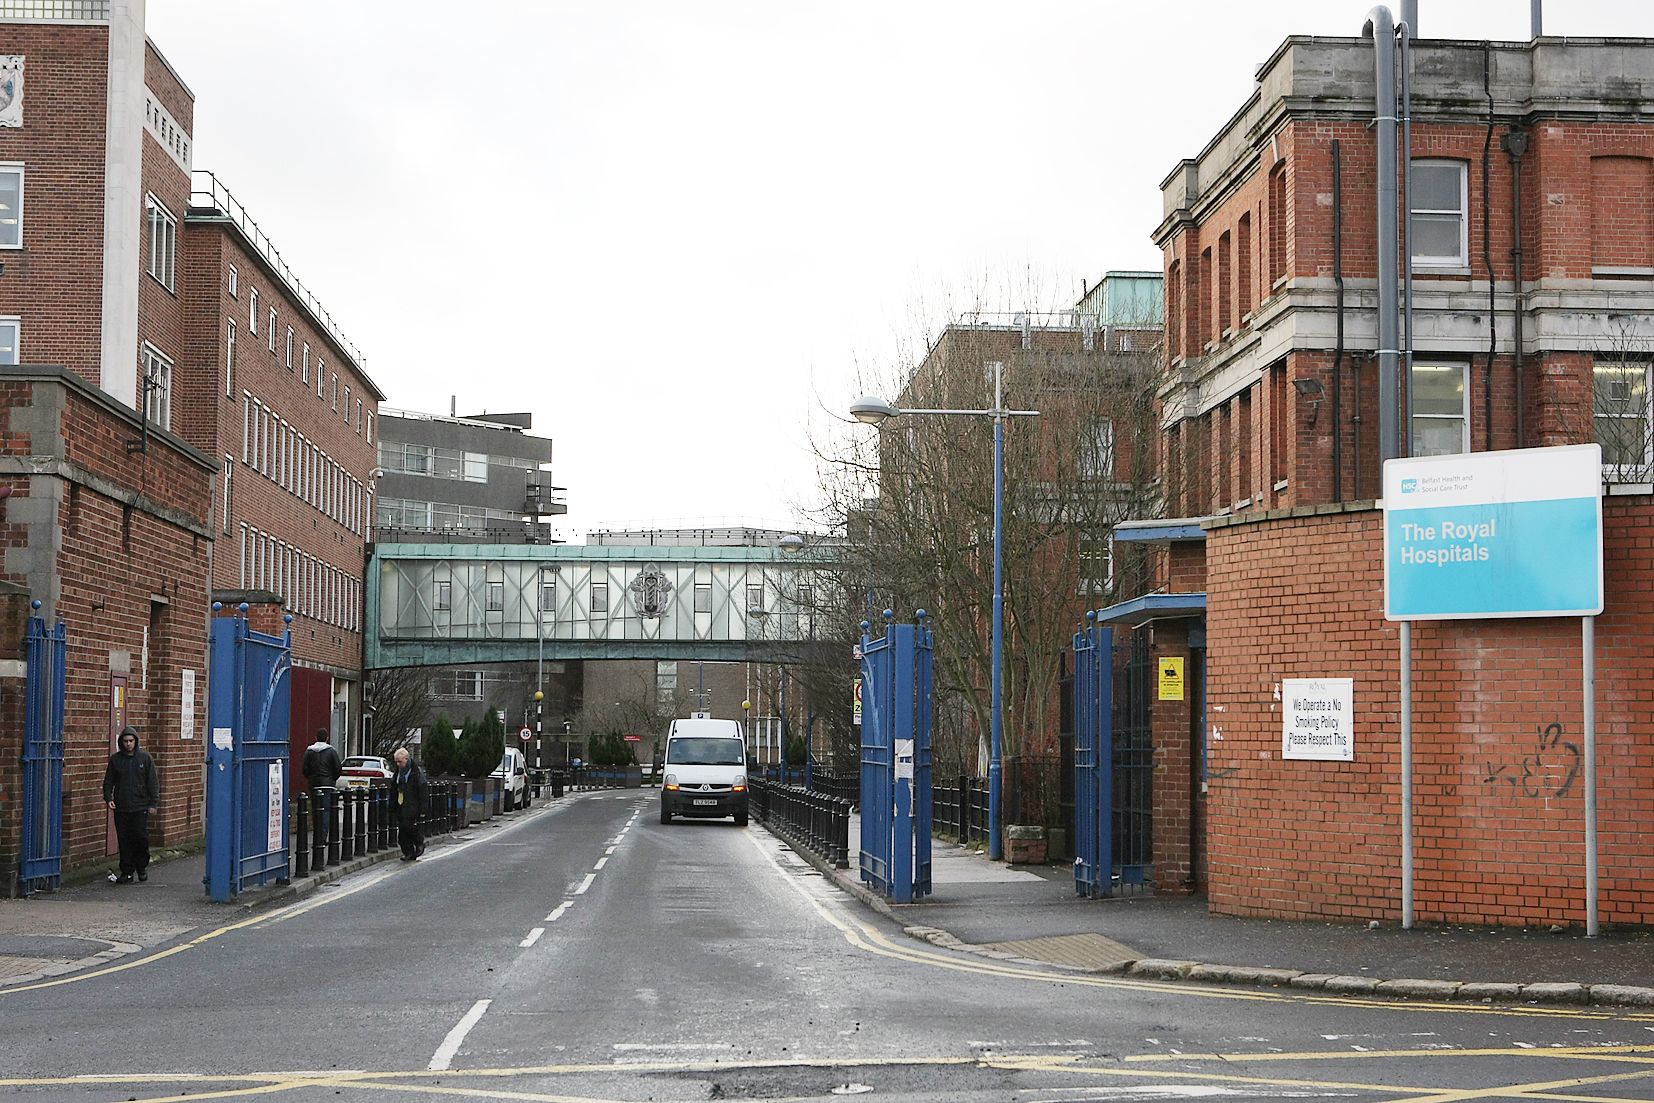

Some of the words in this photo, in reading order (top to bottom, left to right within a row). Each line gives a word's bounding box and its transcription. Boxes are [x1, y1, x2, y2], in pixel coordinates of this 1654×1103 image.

[1421, 476, 1441, 484] Belfast
[1421, 485, 1439, 493] Social
[1439, 484, 1453, 492] Care
[1453, 483, 1468, 491] Trust
[1401, 523, 1436, 542] The
[1441, 519, 1496, 543] Royal
[1401, 543, 1489, 567] Hospitals
[1293, 698, 1302, 711] We
[1302, 698, 1326, 714] Operate
[1327, 701, 1331, 711] a
[1332, 698, 1342, 711] No
[1295, 715, 1320, 731] Smoking
[1320, 715, 1339, 731] Policy
[1289, 732, 1307, 745] Please
[1308, 732, 1332, 747] Respect
[1333, 732, 1347, 745] This
